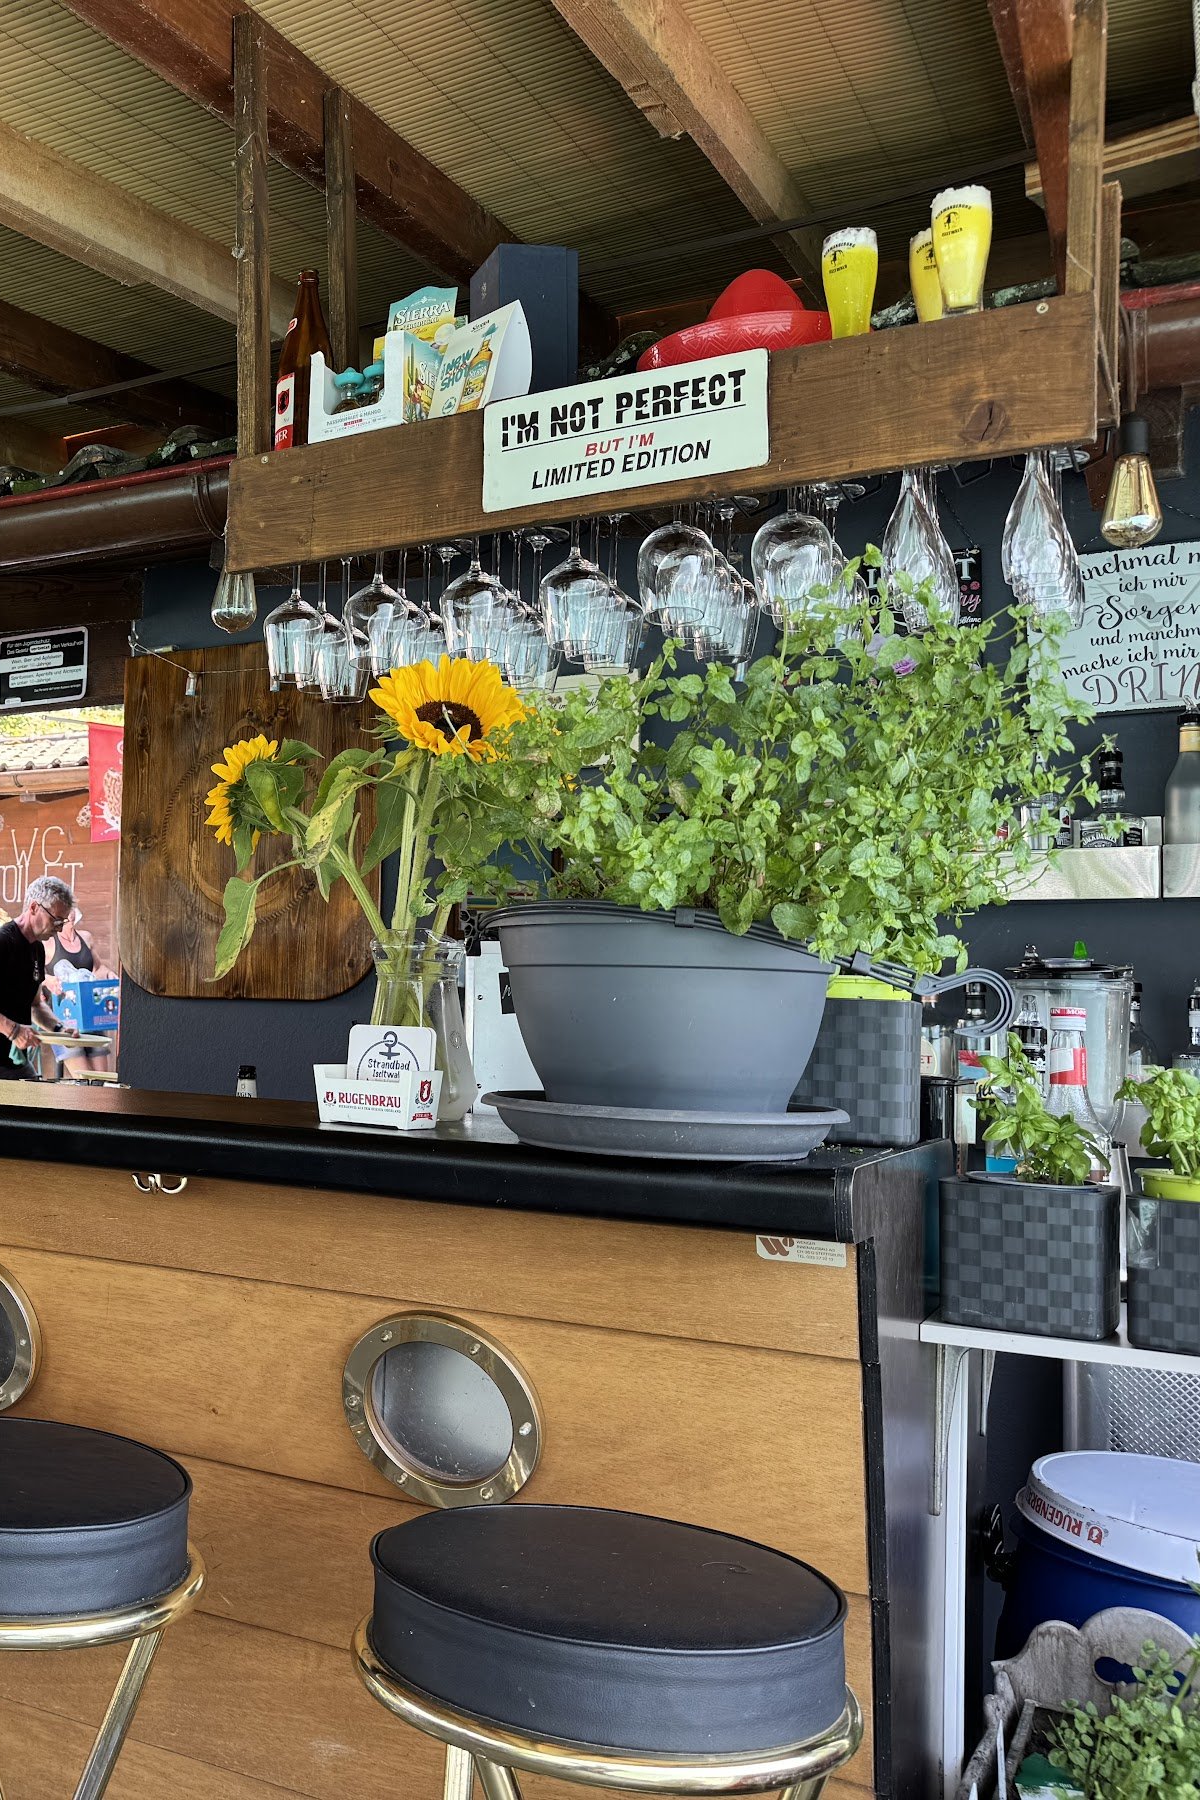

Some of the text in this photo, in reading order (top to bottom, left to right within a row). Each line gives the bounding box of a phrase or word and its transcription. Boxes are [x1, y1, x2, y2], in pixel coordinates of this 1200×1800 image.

[394, 301, 450, 326] SIERRA
[501, 368, 746, 447] I'M NOT PERFECT
[585, 432, 655, 457] BUT I'M
[531, 439, 711, 490] LIMITED EDITION
[1082, 545, 1180, 581] nchmal
[1119, 572, 1187, 593] ich mir
[1090, 623, 1200, 646] und manchm
[1062, 643, 1200, 680] mache ich mir
[1082, 662, 1200, 706] DRIN
[11, 826, 65, 866] WC
[367, 1058, 411, 1071] Strandbad
[372, 1069, 400, 1079] Iseltwal
[338, 1091, 401, 1109] RUGENBRÄU
[1027, 1490, 1083, 1537] RUGENBR
